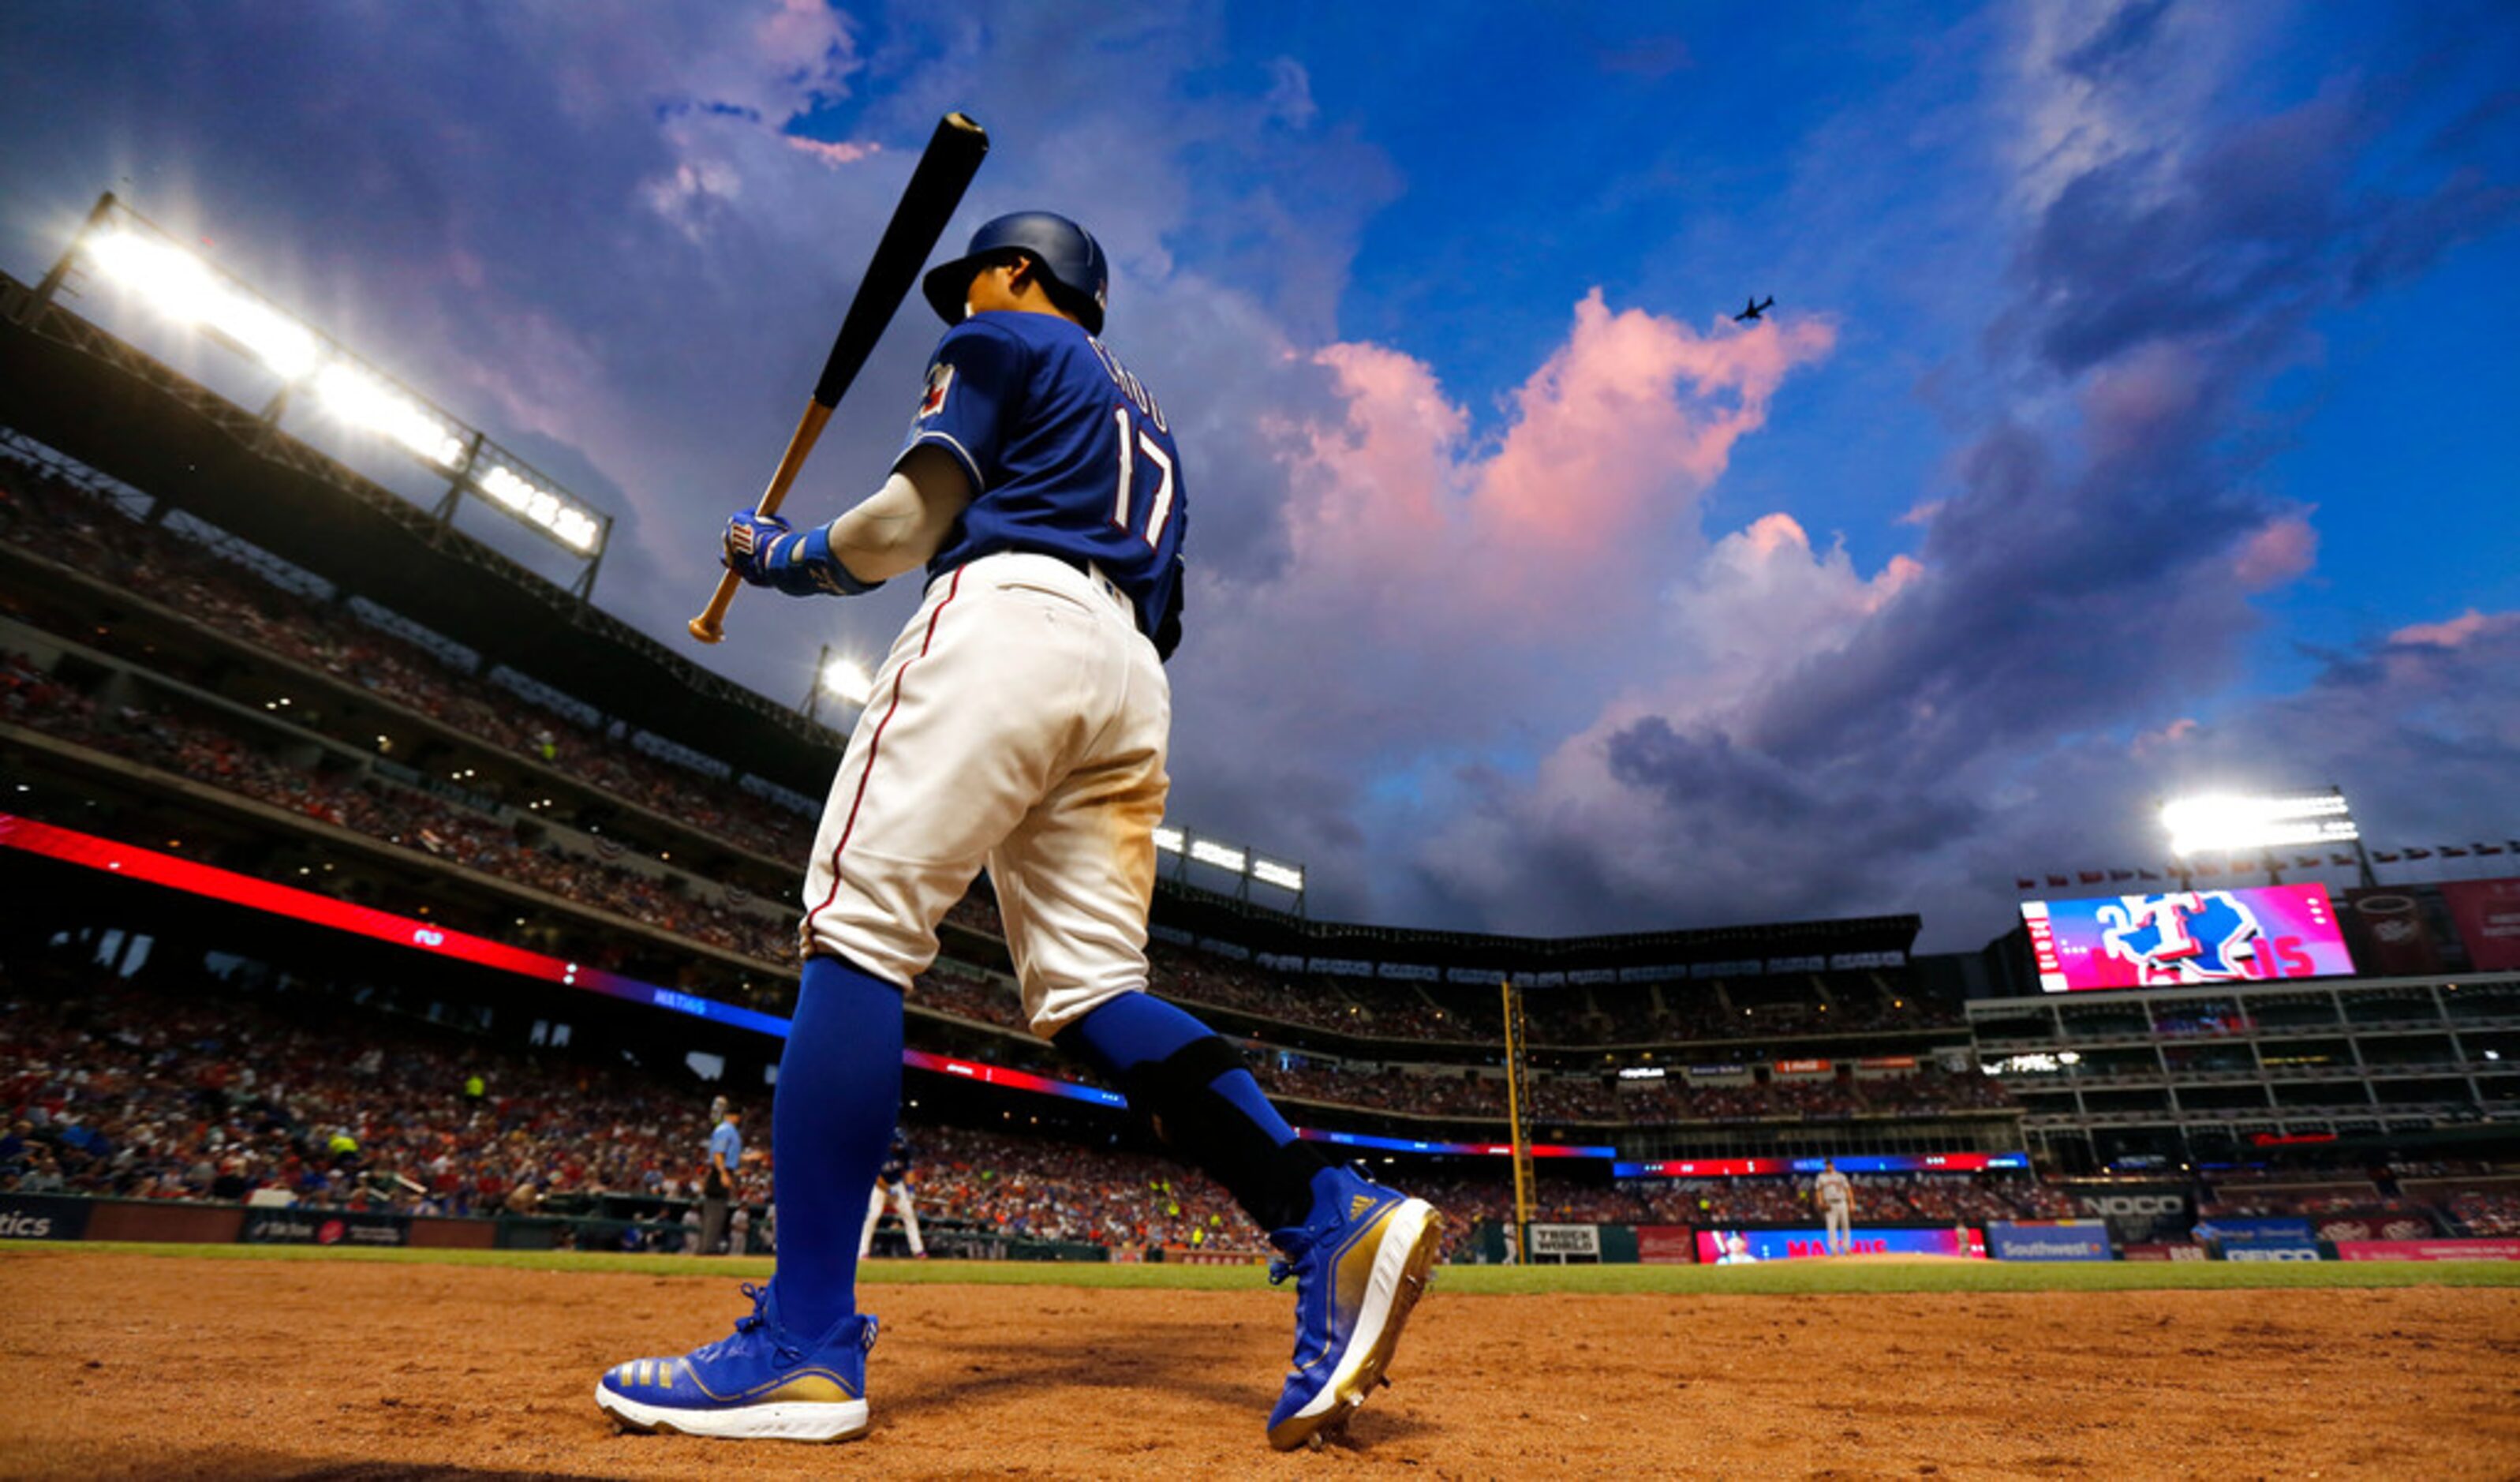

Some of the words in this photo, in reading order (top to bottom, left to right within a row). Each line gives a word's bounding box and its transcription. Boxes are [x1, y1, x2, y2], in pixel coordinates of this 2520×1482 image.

[1109, 402, 1174, 555] 17
[2082, 1196, 2183, 1215] NOCO
[1538, 1229, 1591, 1240] TRUCK
[1539, 1241, 1593, 1251] WORLD
[2002, 1241, 2089, 1256] Southwest
